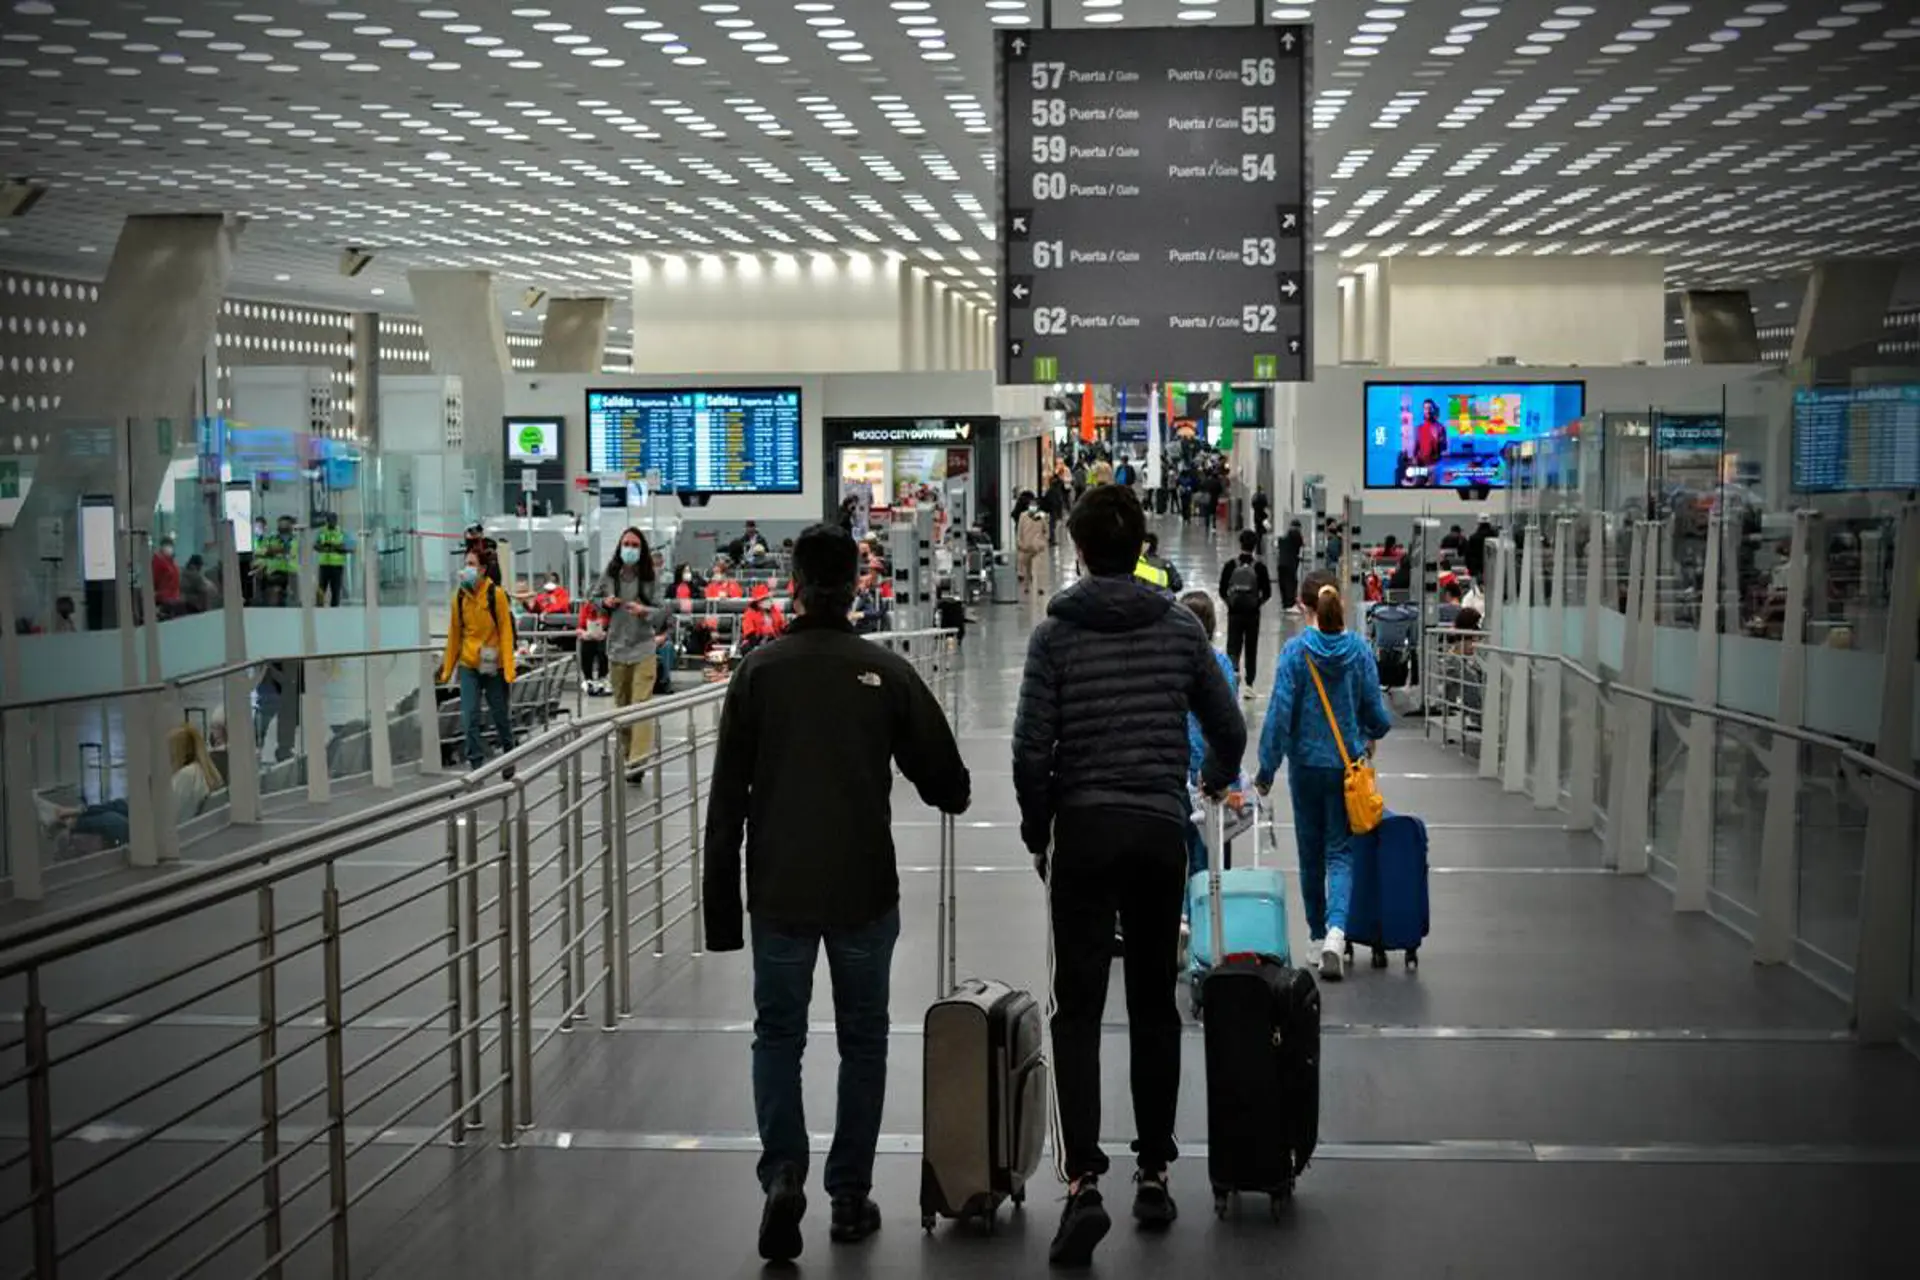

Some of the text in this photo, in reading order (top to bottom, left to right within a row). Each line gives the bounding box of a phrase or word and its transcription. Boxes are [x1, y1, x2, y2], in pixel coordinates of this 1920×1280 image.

[1032, 62, 1065, 89] 57
[1069, 70, 1106, 82] Puerta
[1116, 70, 1140, 81] Gate
[1168, 68, 1206, 81] Puerta
[1215, 69, 1238, 81] Gate
[1241, 58, 1275, 86] 56
[1032, 99, 1066, 126] 58
[1069, 108, 1107, 120] Puerta
[1115, 108, 1140, 120] Gate
[1168, 117, 1206, 130] Puerta
[1215, 118, 1239, 129] Gate
[1242, 107, 1275, 134] 55
[1033, 136, 1066, 163] 59
[1069, 146, 1107, 158] Puerta
[1116, 146, 1140, 157] Gate
[1169, 165, 1206, 177] Puerta
[1215, 165, 1239, 176] Gate
[1242, 154, 1276, 181] 54
[1033, 173, 1066, 199] 60
[1069, 183, 1107, 196] Puerta
[1116, 184, 1140, 196] Gate
[1033, 240, 1063, 268] 61
[1070, 250, 1107, 262] Puerta
[1116, 250, 1140, 262] Gate
[1169, 249, 1207, 262] Puerta
[1216, 250, 1240, 260] Gate
[1242, 238, 1276, 266] 53
[1034, 307, 1067, 334] 62
[1070, 314, 1107, 327] Puerta
[1116, 315, 1140, 326] Gate
[1169, 316, 1207, 328] Puerta
[1216, 316, 1240, 328] Gate
[1243, 305, 1276, 332] 52
